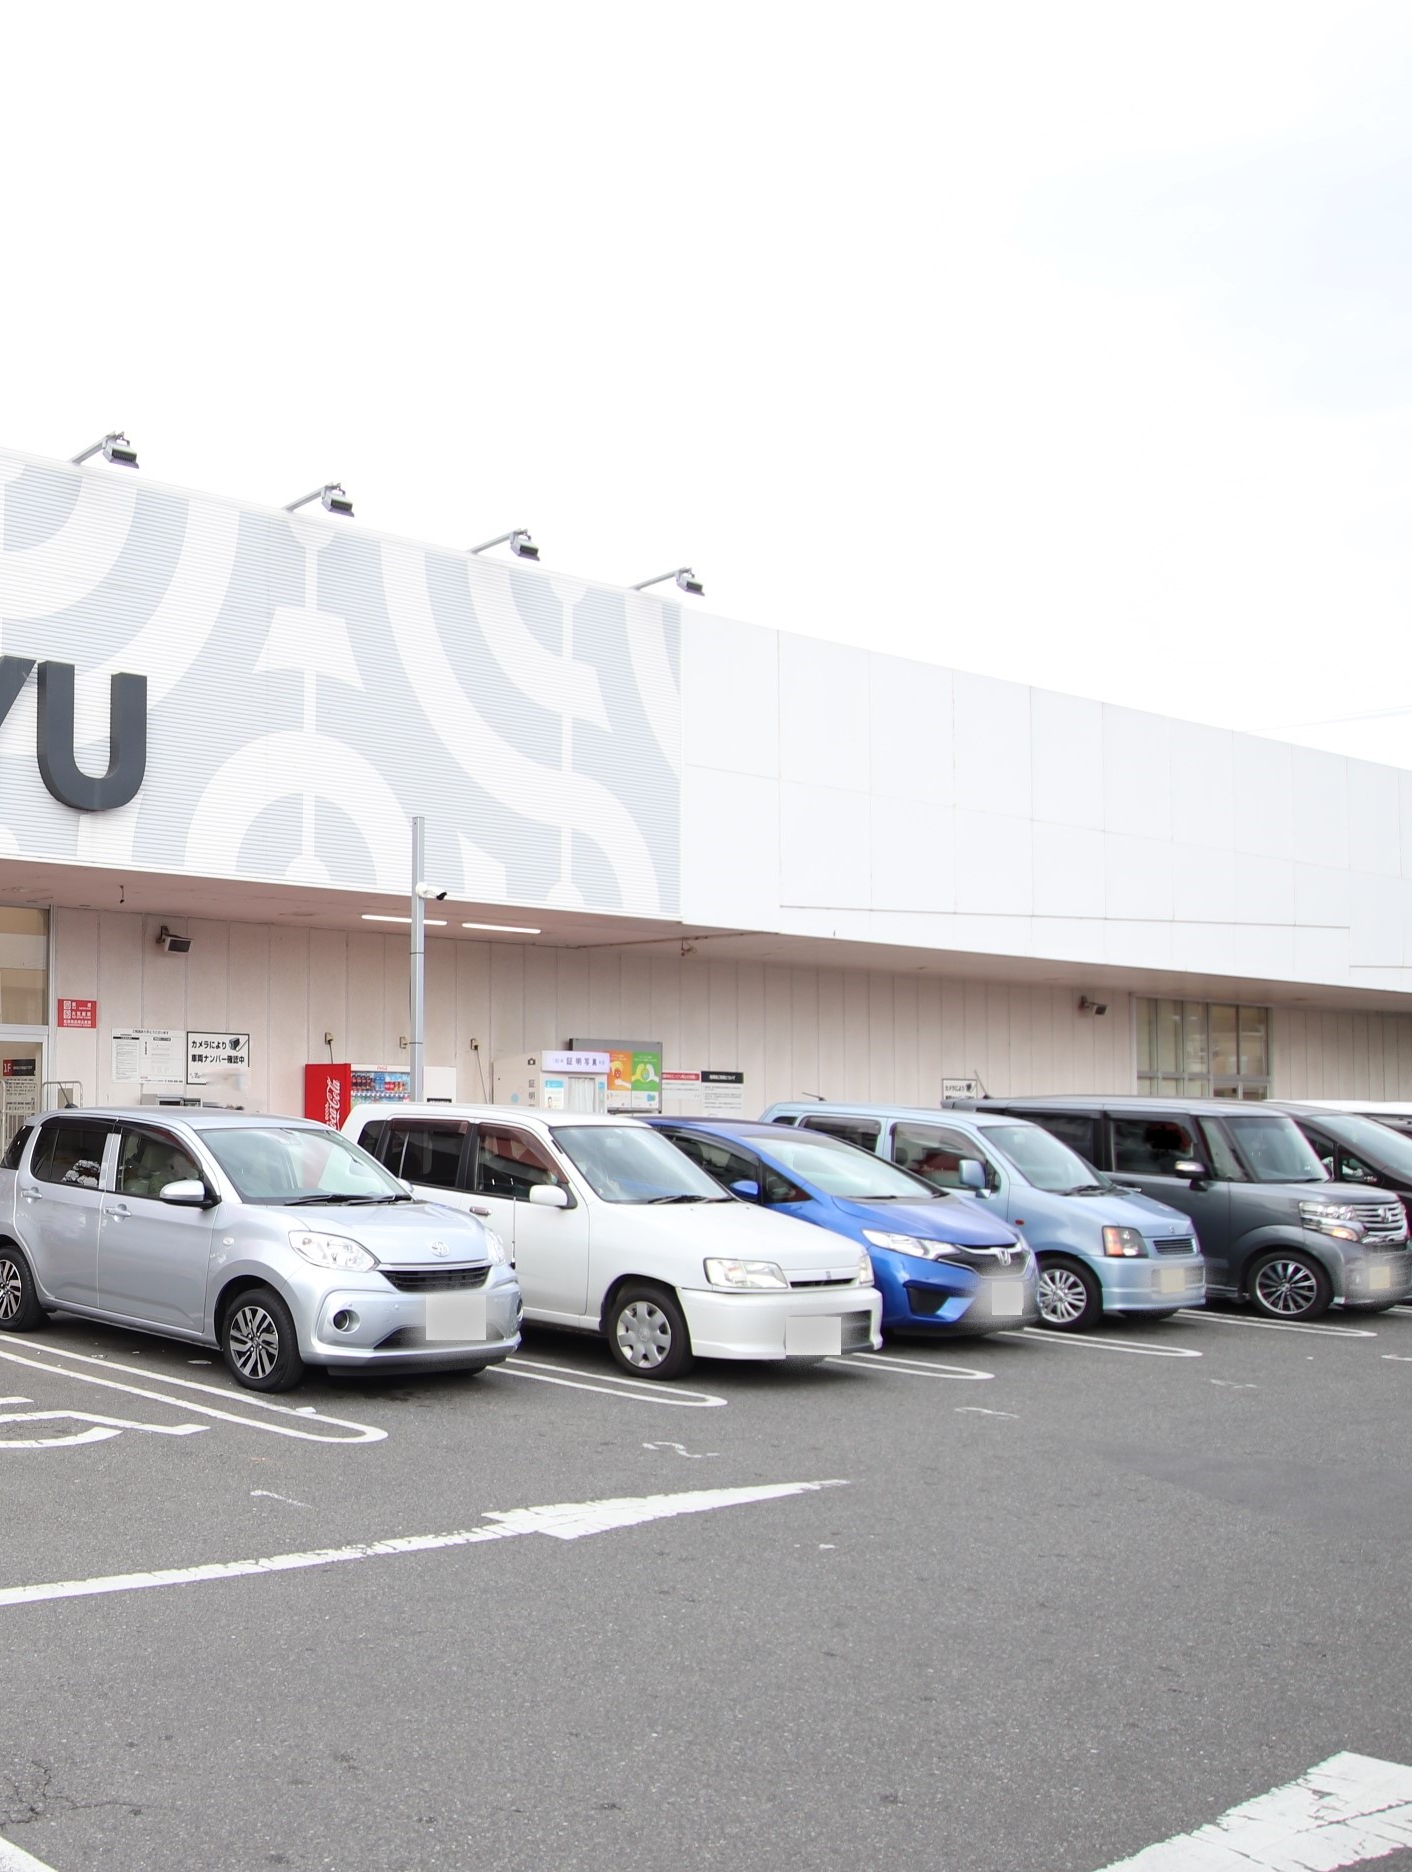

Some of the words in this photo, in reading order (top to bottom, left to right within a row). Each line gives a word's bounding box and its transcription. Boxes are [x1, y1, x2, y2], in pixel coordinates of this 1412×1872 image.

[191, 1040, 227, 1050] カメラにより
